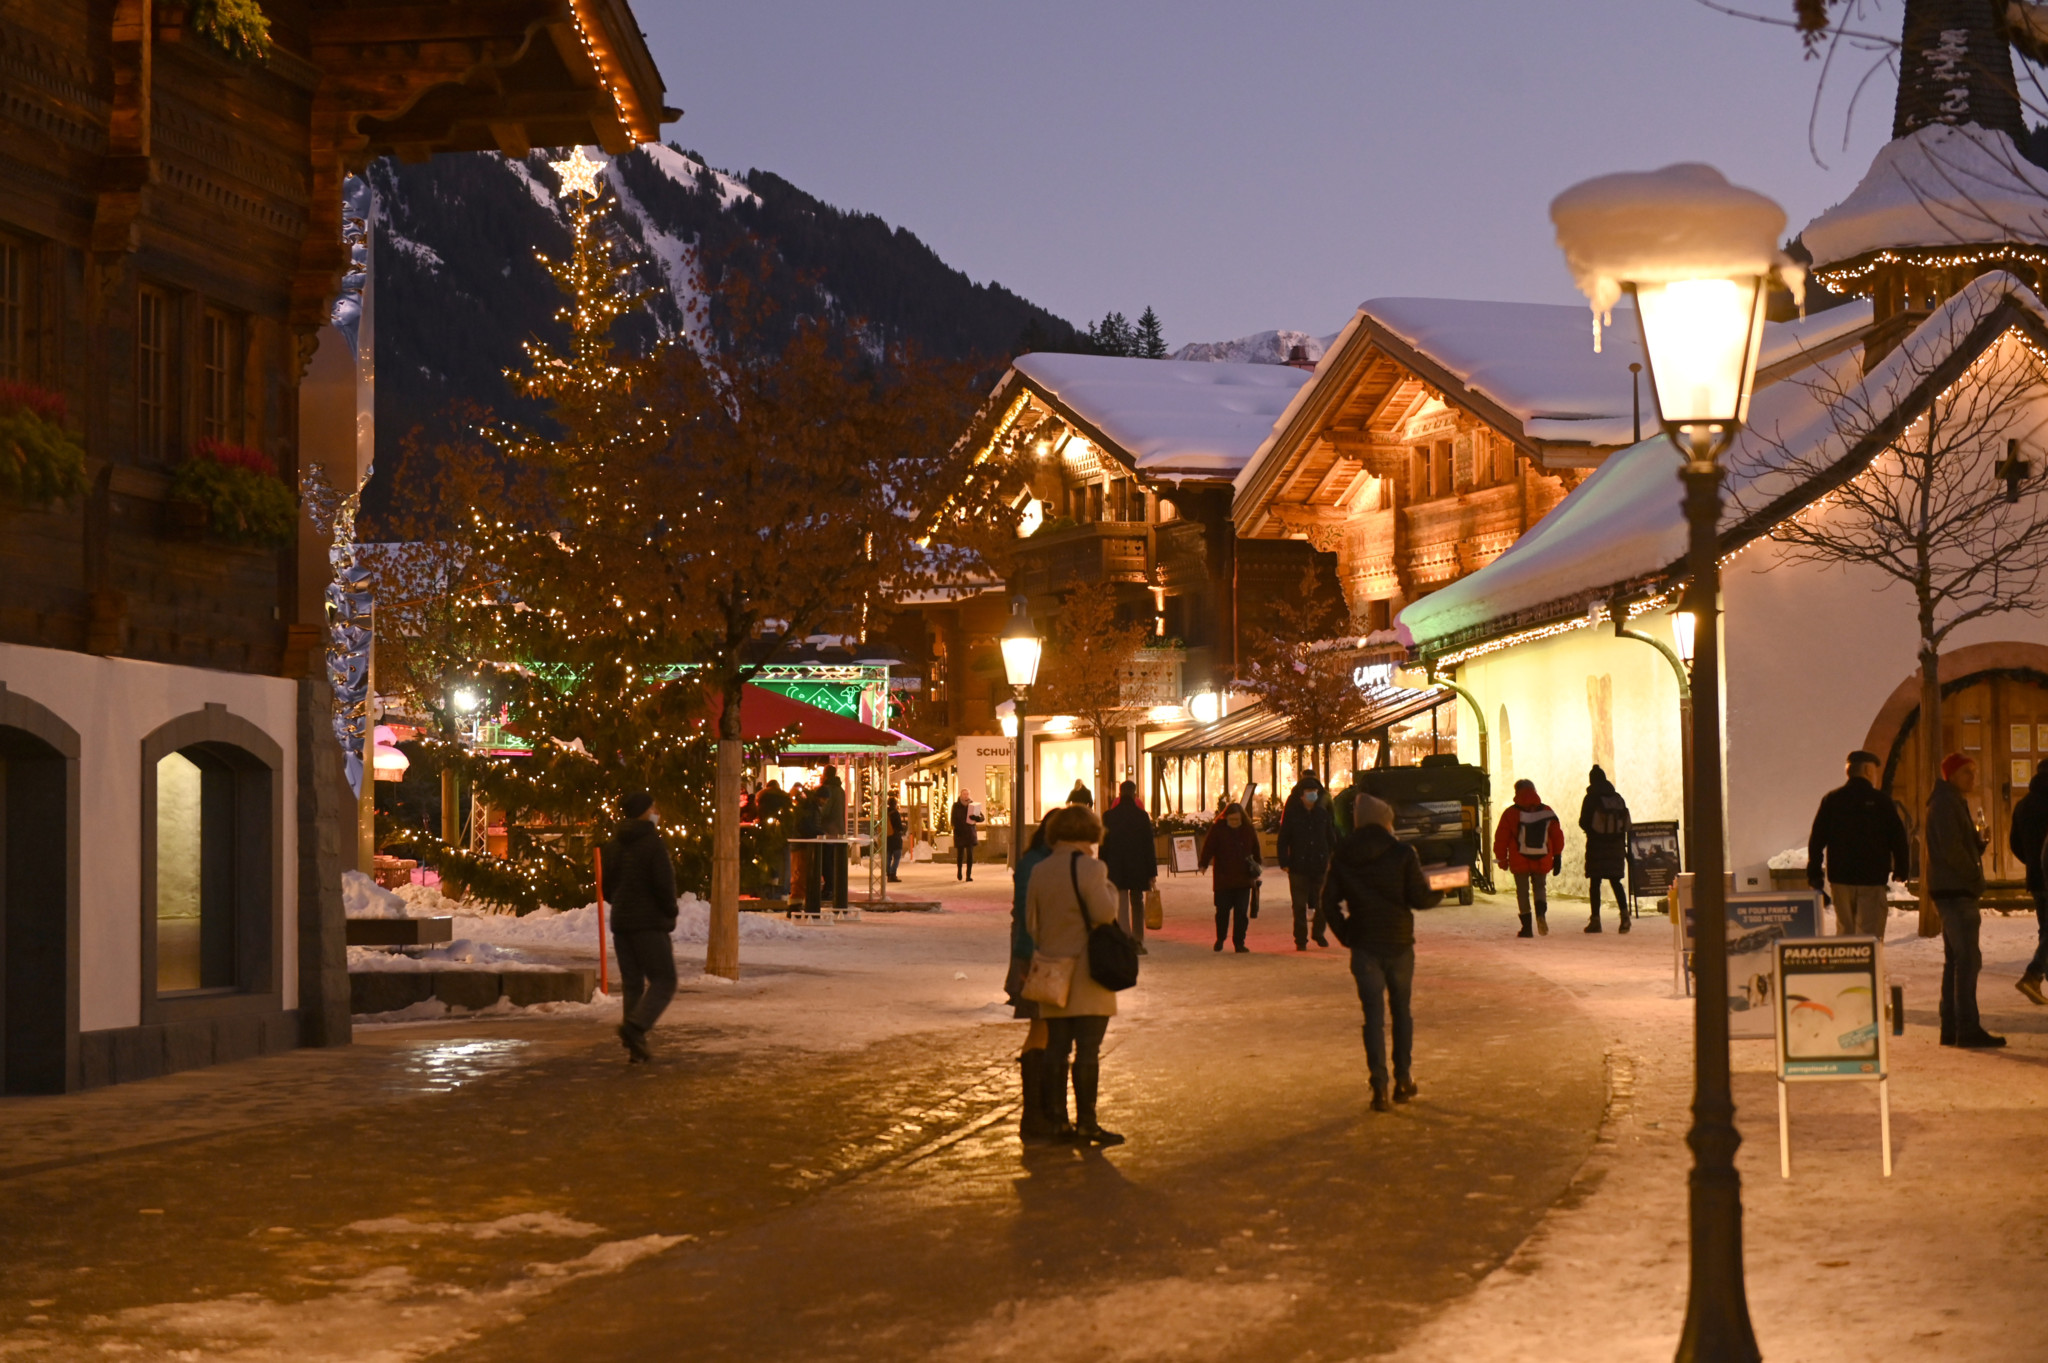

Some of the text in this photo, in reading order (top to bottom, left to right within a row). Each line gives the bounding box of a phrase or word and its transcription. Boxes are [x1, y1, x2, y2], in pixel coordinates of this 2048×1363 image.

[976, 748, 1016, 756] SCHUH
[1768, 906, 1788, 914] PAWS
[1784, 946, 1871, 959] PARAGLIDING
